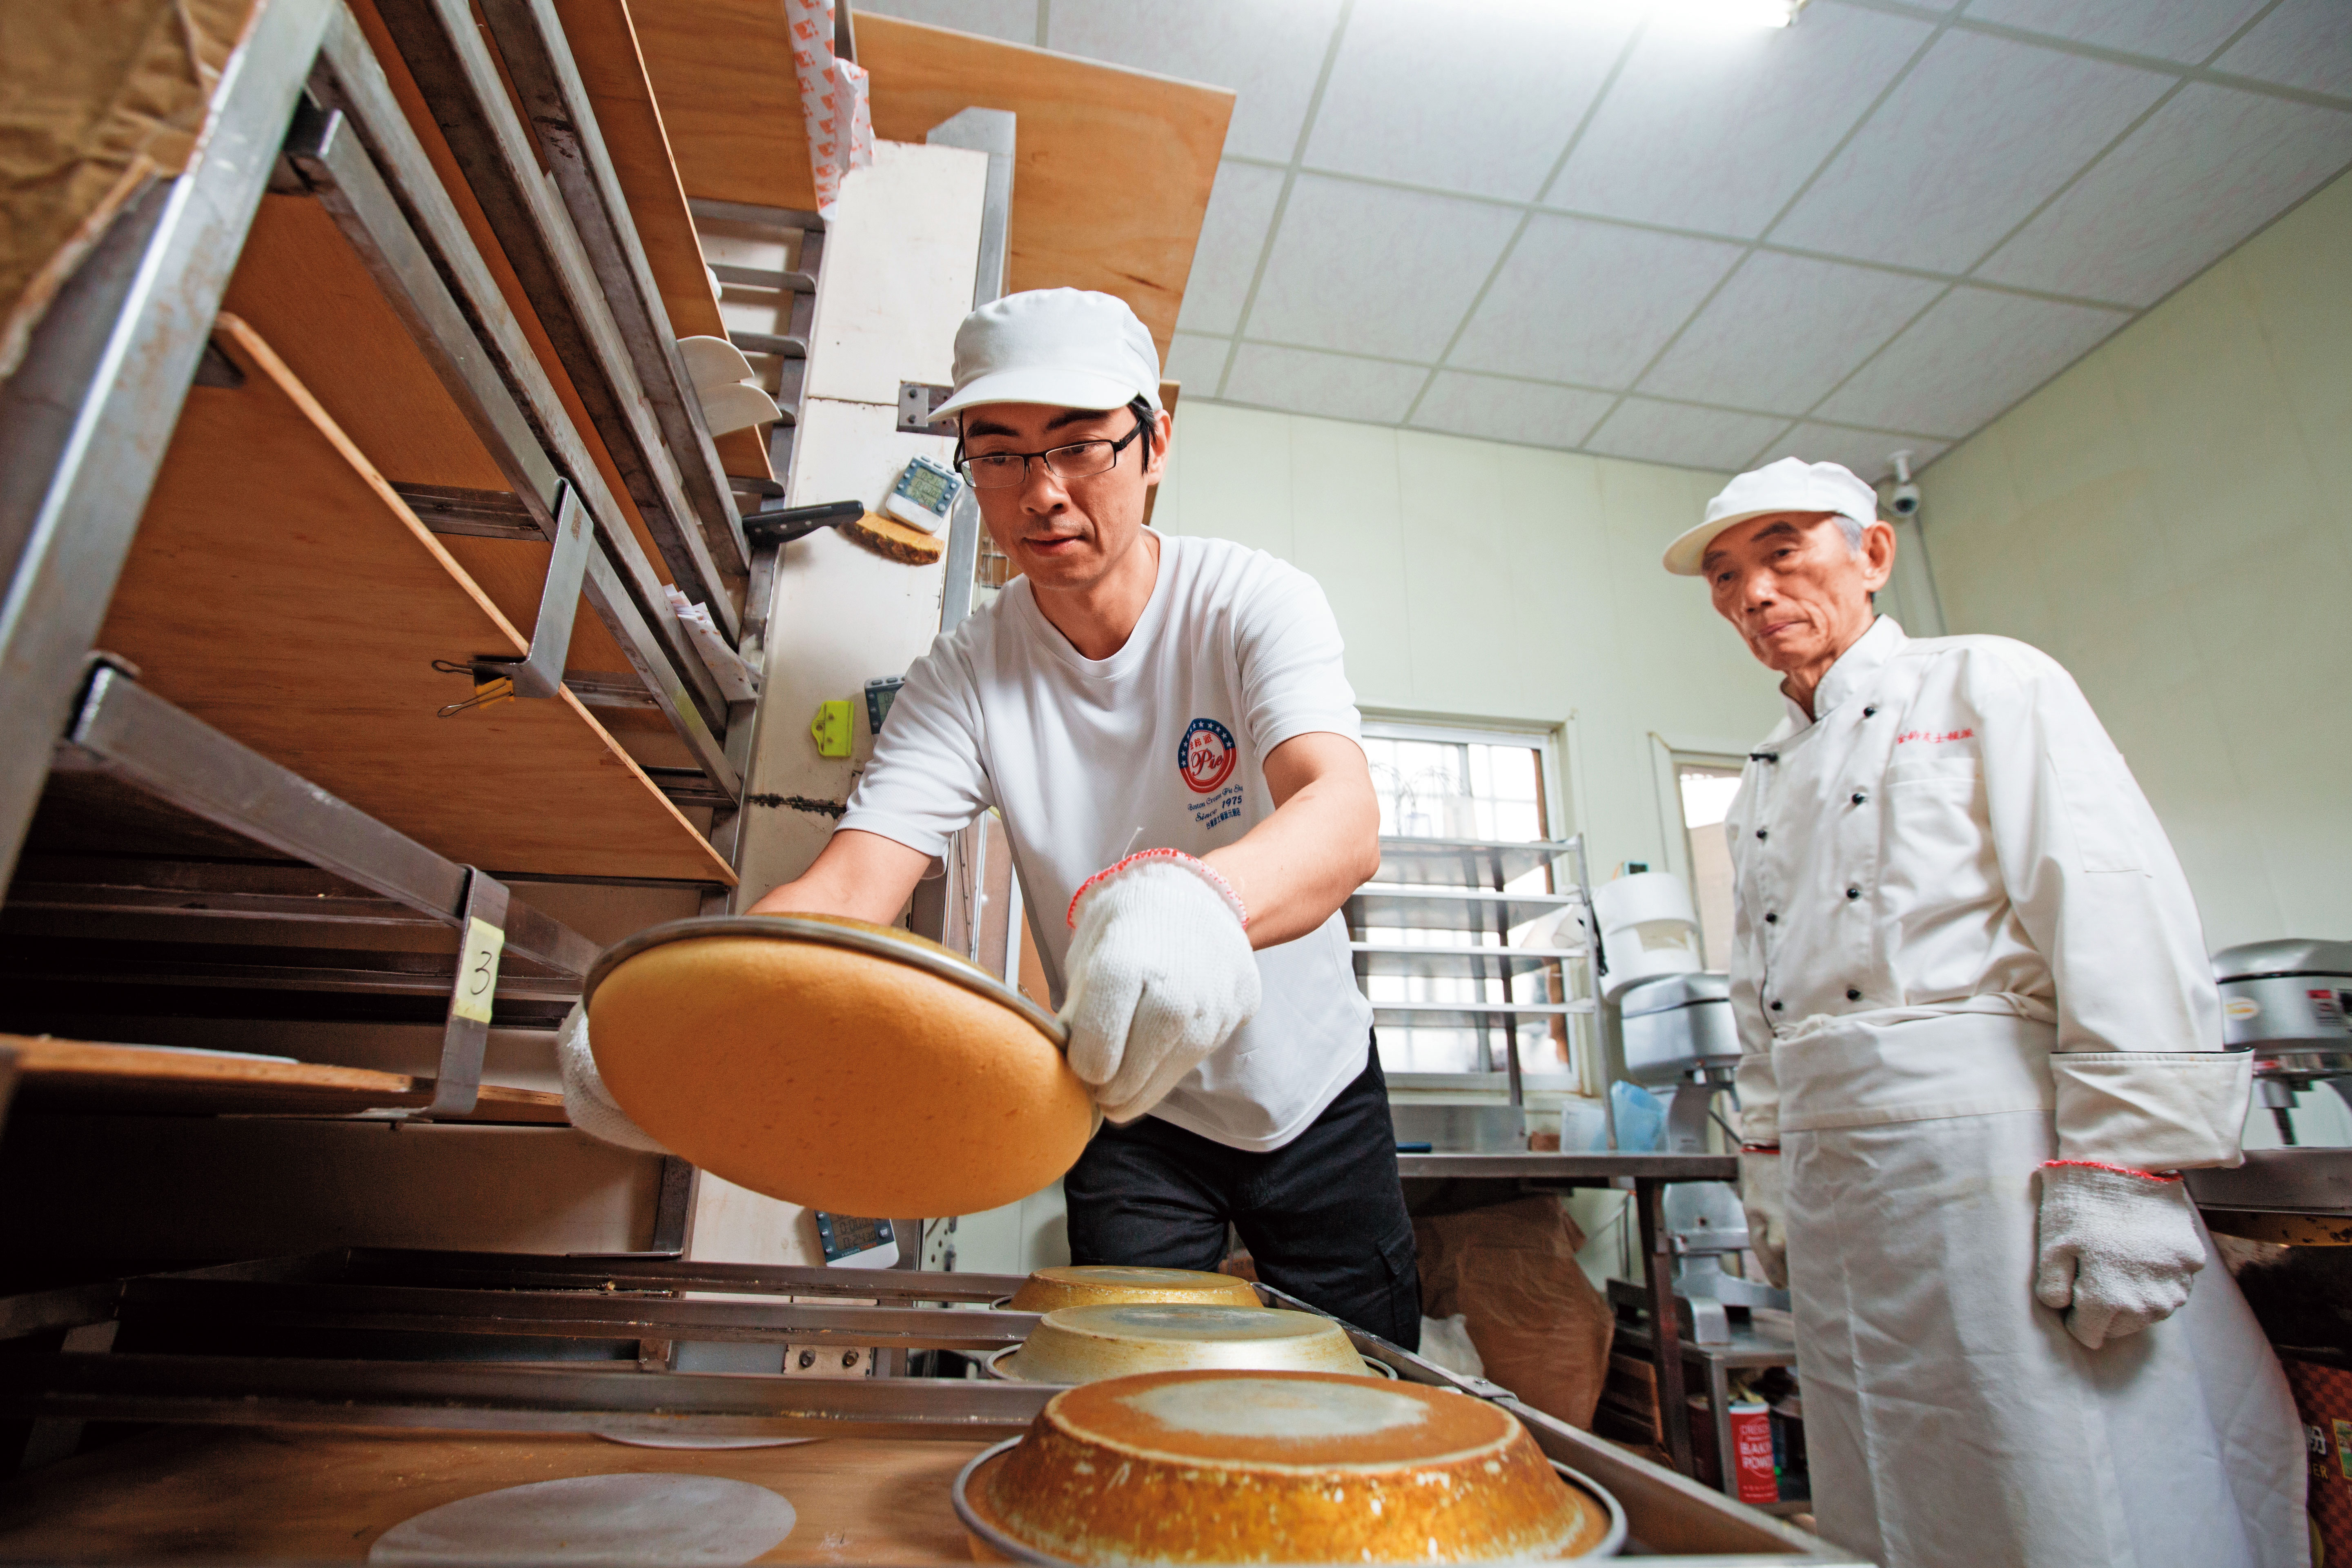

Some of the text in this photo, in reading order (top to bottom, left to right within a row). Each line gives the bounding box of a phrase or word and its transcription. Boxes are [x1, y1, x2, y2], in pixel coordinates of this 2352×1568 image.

[1191, 748, 1223, 776] Pie
[1188, 802, 1205, 811] Boston
[1206, 793, 1221, 805] Cream
[1222, 787, 1232, 795] Pie
[1196, 795, 1242, 822] Since 1975
[470, 951, 492, 995] 3
